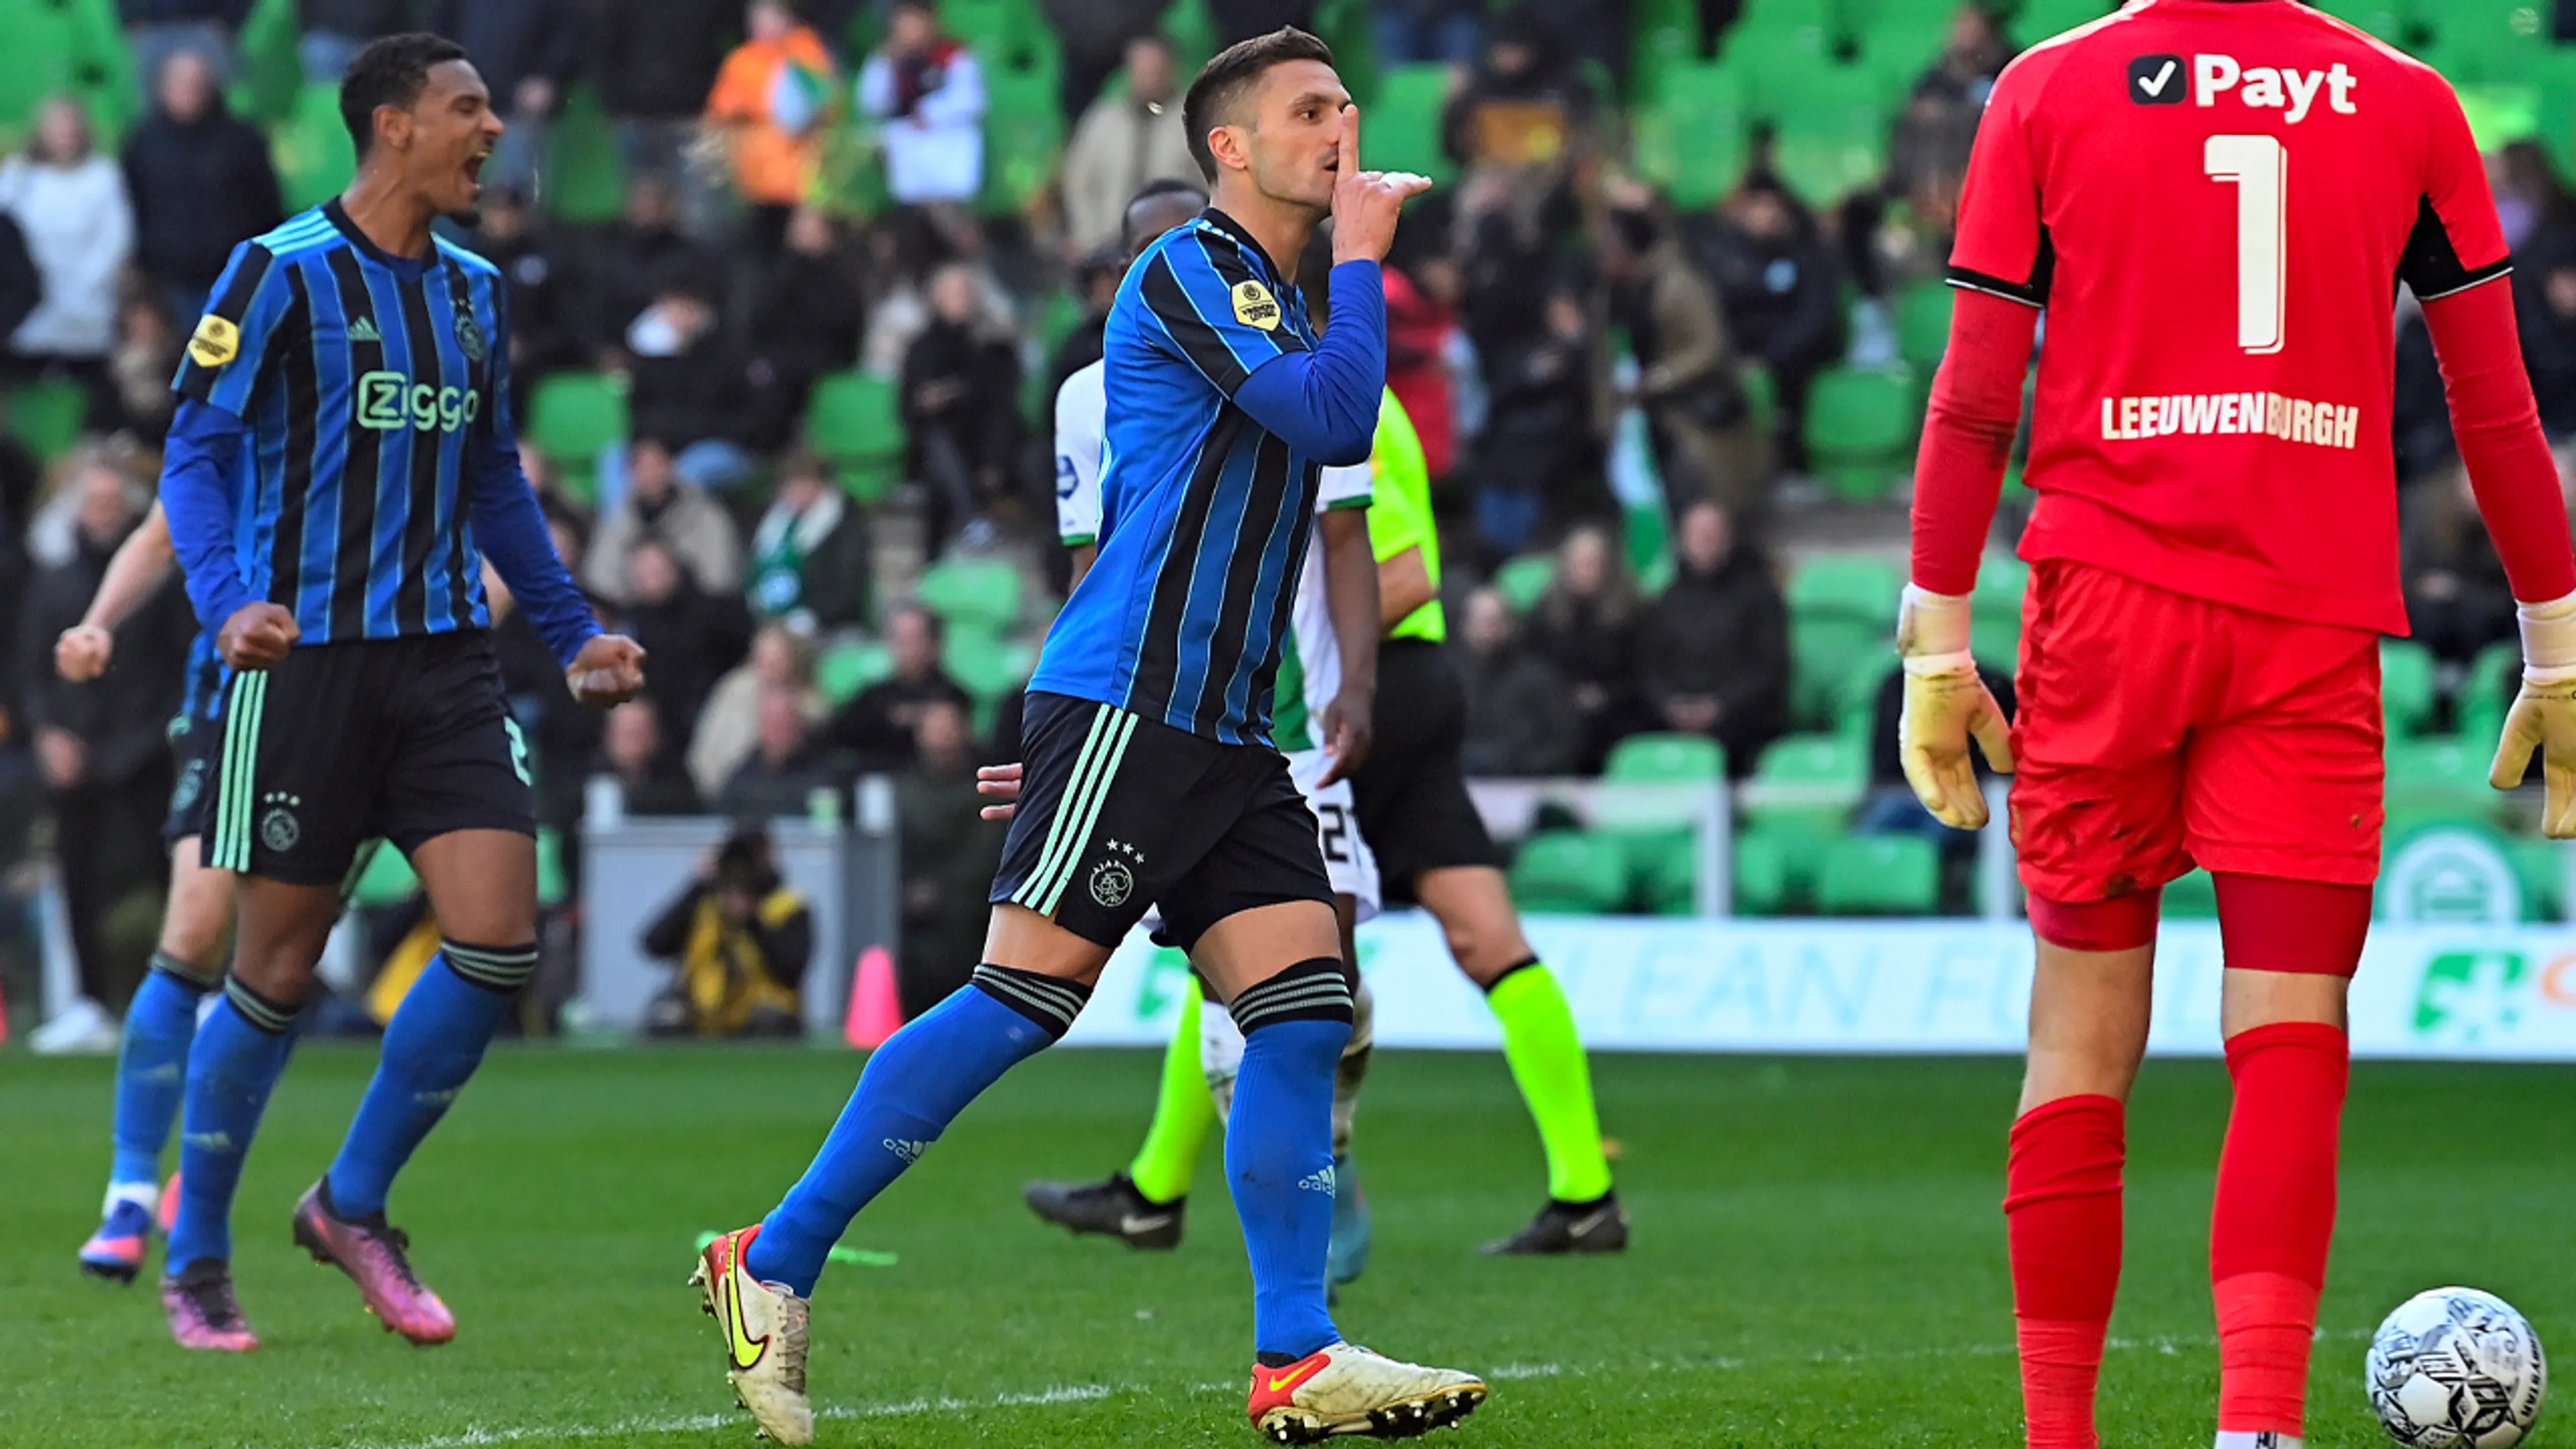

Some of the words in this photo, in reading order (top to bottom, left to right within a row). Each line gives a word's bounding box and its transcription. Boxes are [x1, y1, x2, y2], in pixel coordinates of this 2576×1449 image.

[2194, 54, 2357, 124] Payt
[2204, 135, 2288, 354] 1
[2101, 392, 2359, 449] LEEUWENBURGH
[1469, 939, 1882, 1030] LEAN
